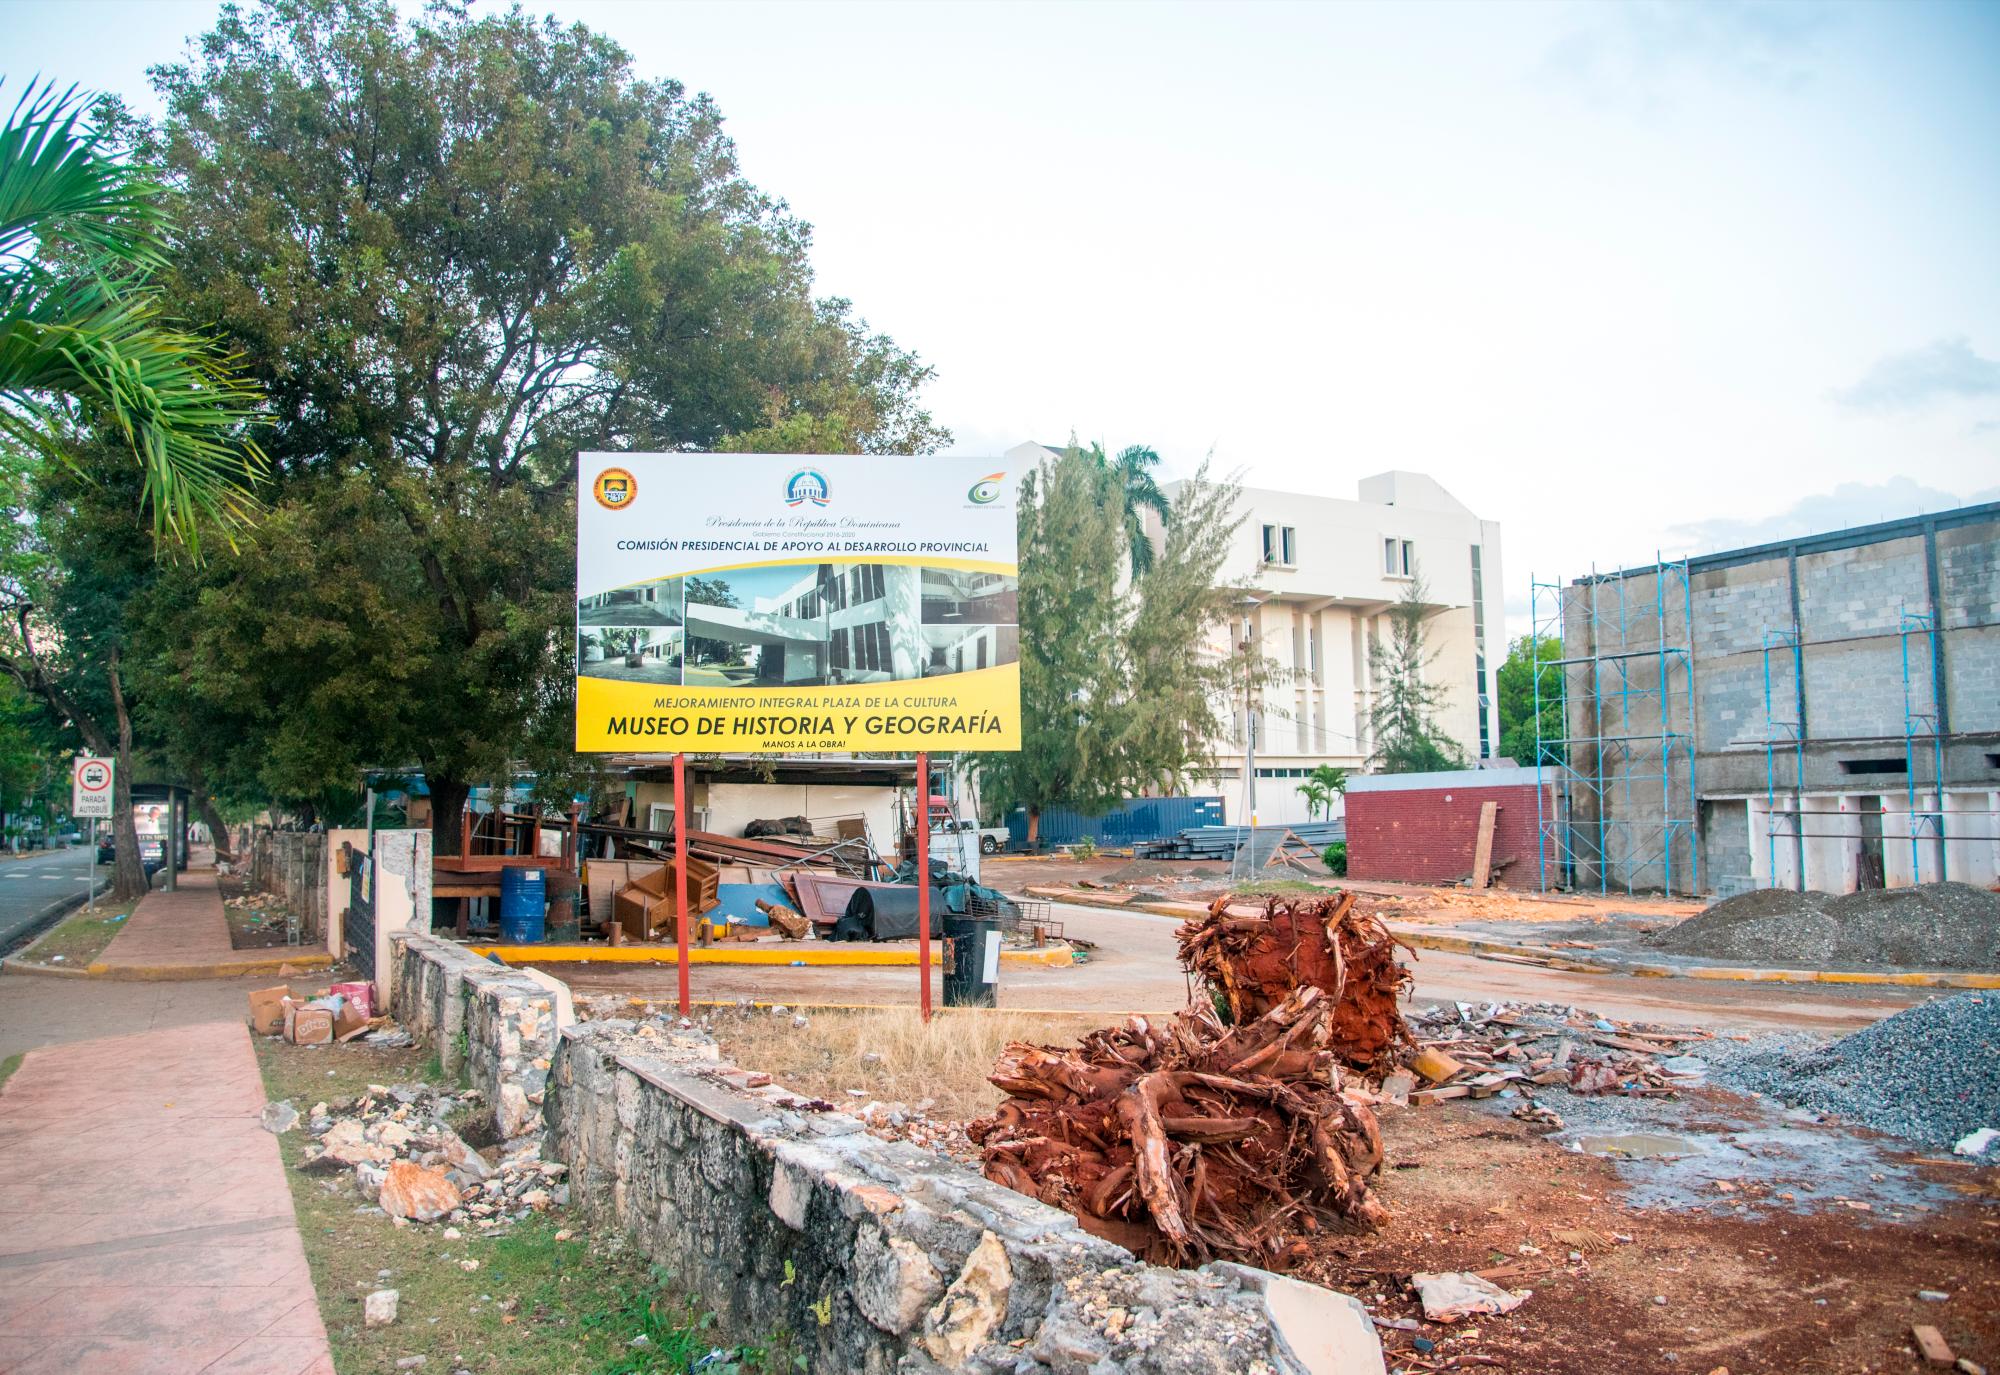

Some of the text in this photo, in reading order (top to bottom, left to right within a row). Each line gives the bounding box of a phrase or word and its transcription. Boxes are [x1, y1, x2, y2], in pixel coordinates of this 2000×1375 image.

[706, 516, 761, 528] Presidencia
[763, 517, 775, 528] de
[776, 517, 787, 528] la
[839, 516, 901, 529] Dominicana
[616, 538, 989, 552] COMISIÓN PRESIDENCIAL DE APOYO AL DESARROLLO PROVINCIAL
[653, 697, 958, 709] MEJORAMIENTO INTEGRAL PLAZA DE LA CULTURA
[607, 709, 1002, 735] MUSEO DE HISTORIA Y GEOGRAFÍA
[762, 740, 846, 748] MANOS A LA OBRA!
[81, 795, 106, 803] PARADA
[79, 805, 108, 814] AUTOBUS
